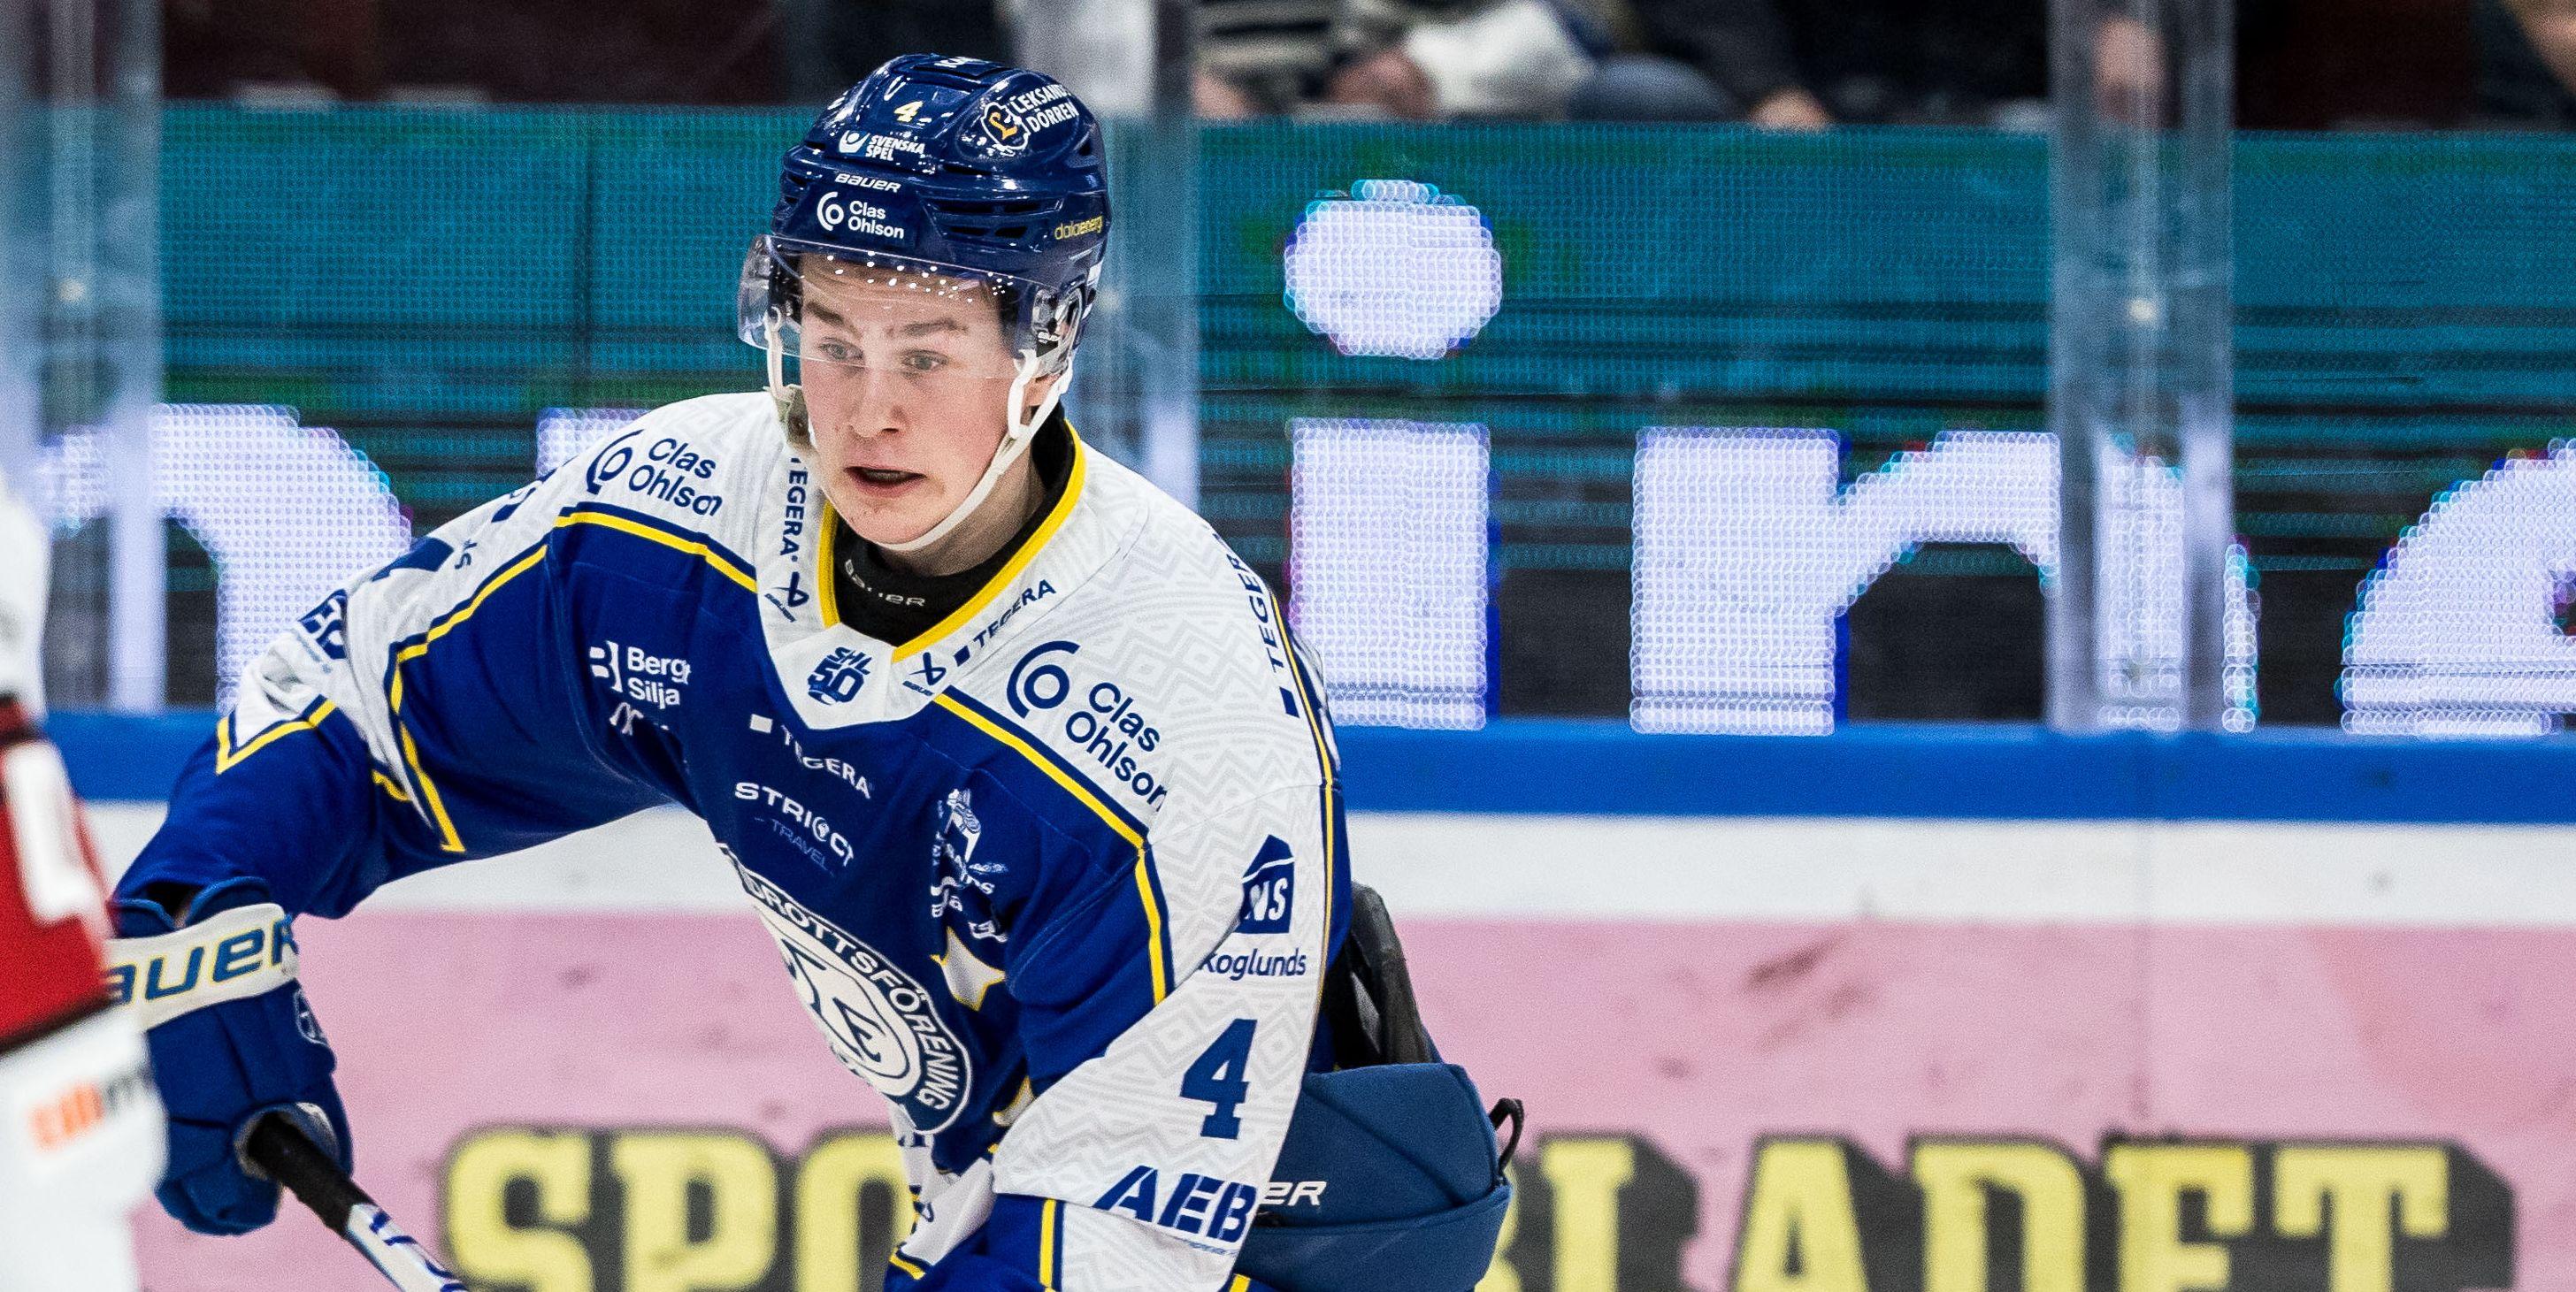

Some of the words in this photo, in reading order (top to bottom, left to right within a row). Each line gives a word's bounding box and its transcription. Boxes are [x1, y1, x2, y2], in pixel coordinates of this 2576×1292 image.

[893, 101, 924, 122] 4
[1025, 98, 1079, 133] DÖRREN
[865, 145, 894, 161] SPEL
[870, 135, 925, 154] SVENSKA
[849, 200, 886, 219] Clas
[847, 216, 904, 239] Ohlson
[648, 438, 717, 478] Clas
[1213, 533, 1284, 674] TEGER
[1088, 682, 1161, 752] Clas
[1199, 948, 1307, 981] koglunds
[1179, 1019, 1258, 1140] 4
[1092, 1165, 1258, 1243] AEB
